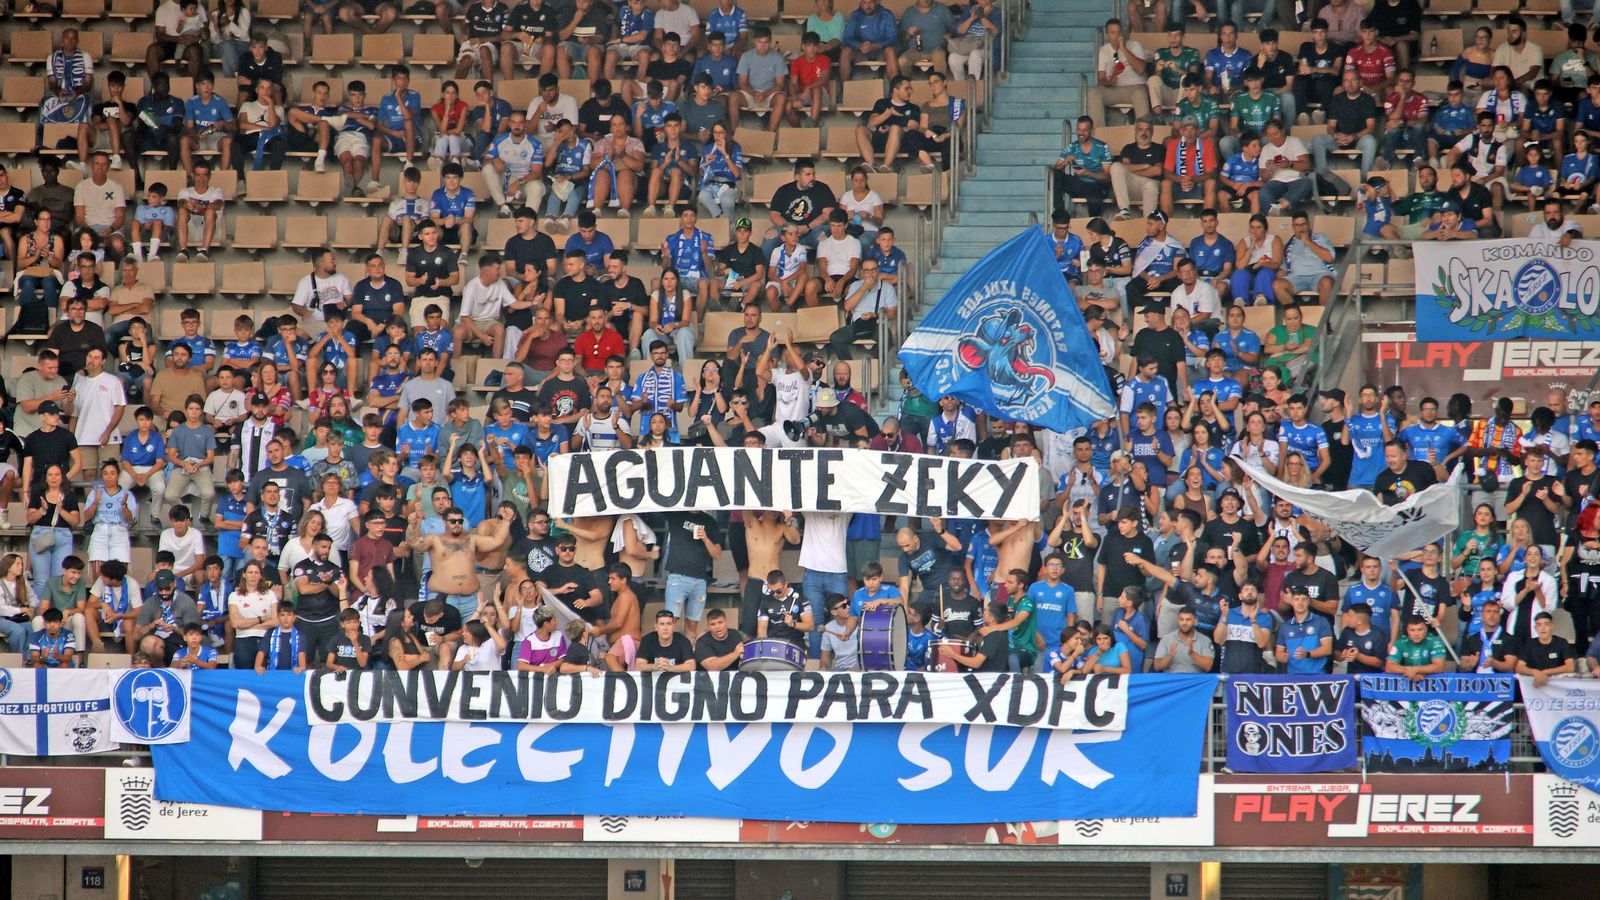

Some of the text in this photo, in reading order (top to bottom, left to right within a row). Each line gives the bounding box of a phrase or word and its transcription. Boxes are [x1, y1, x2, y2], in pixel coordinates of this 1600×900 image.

[1482, 243, 1594, 262] KOMANDO
[1449, 257, 1516, 324] SKA
[1375, 342, 1483, 368] PLAY
[562, 448, 1028, 518] AGUANTE ZEKY
[1361, 676, 1512, 694] SHERRY BOYS
[0, 701, 98, 714] REZ DEPORTIVO FC
[309, 671, 1119, 727] CONVENIO DIGNO PARA XDFC
[1233, 680, 1348, 717] NEW
[1547, 699, 1564, 711] TE
[1236, 719, 1347, 758] ONES
[1266, 785, 1313, 793] ENTRENA,
[159, 807, 208, 819] de Jerez
[1233, 794, 1482, 837] PLAY JEREZ
[85, 876, 101, 886] 118
